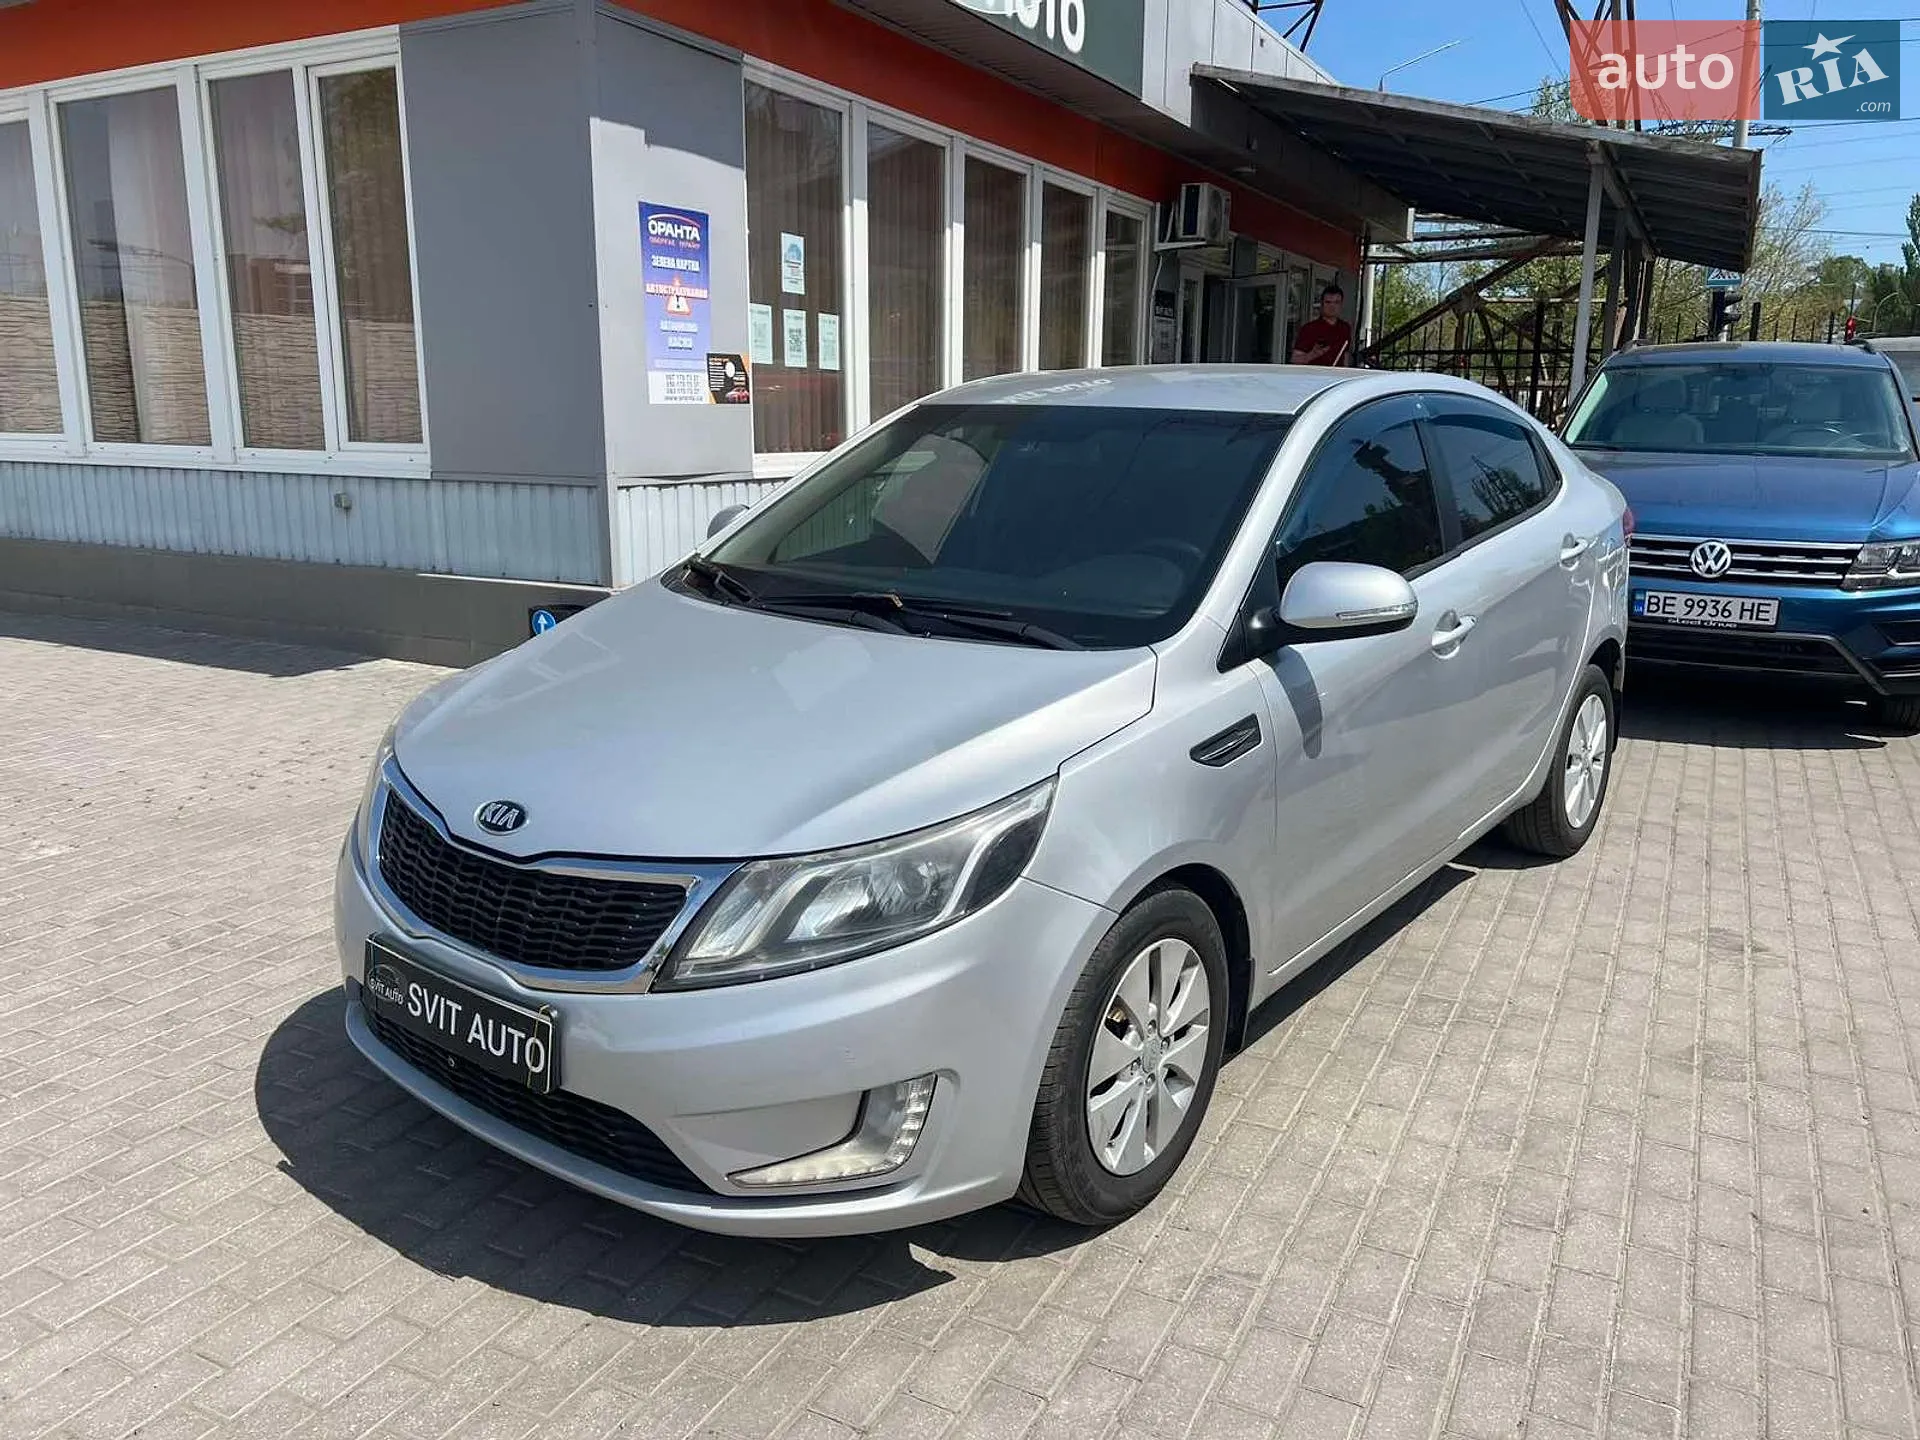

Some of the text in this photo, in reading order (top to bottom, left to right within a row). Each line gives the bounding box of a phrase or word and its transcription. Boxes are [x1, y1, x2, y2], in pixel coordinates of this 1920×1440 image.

[648, 219, 701, 241] ОРАНТА
[1646, 595, 1771, 622] BE 9936 HE
[481, 802, 519, 829] KIA
[407, 982, 546, 1074] SVIT AUTO
